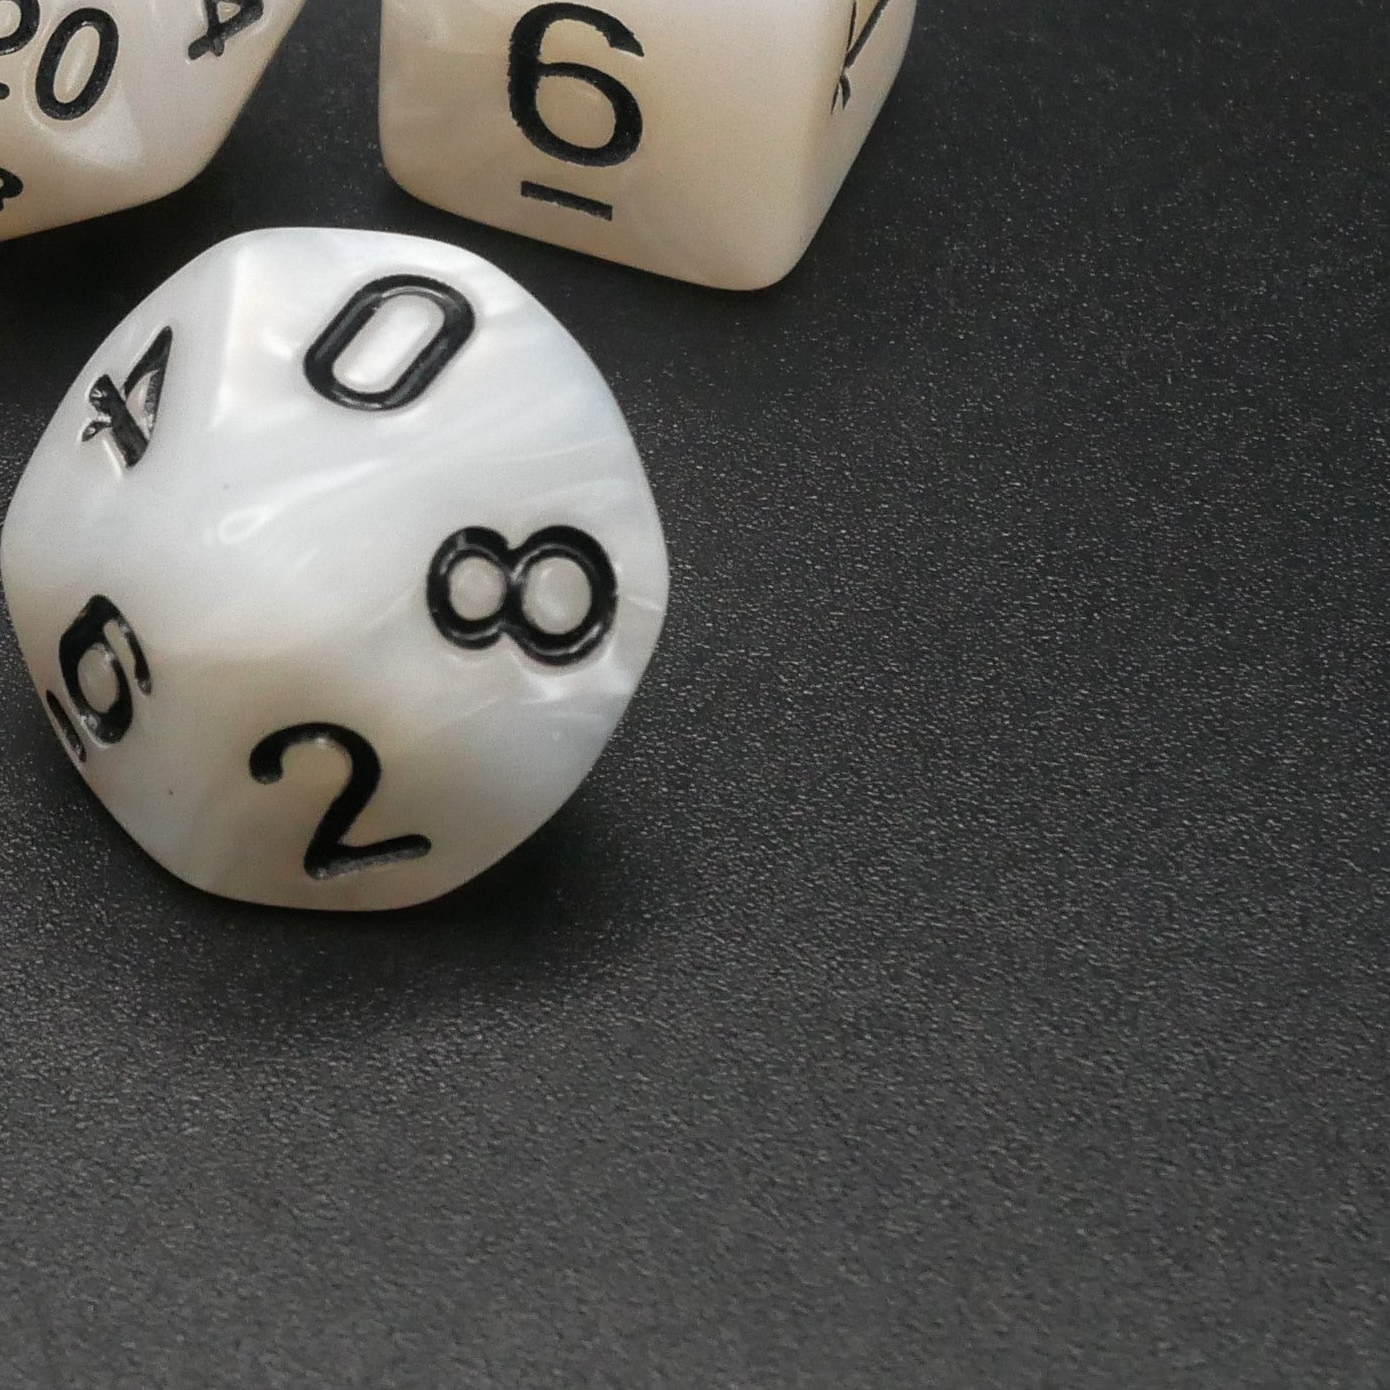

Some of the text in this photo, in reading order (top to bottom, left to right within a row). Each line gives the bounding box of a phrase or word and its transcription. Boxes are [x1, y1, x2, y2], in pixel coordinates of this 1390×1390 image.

[506, 1, 646, 222] 6
[80, 325, 174, 470] 4
[302, 273, 477, 412] 0
[425, 524, 619, 667] 8
[46, 593, 153, 765] 6
[248, 720, 433, 881] 2
